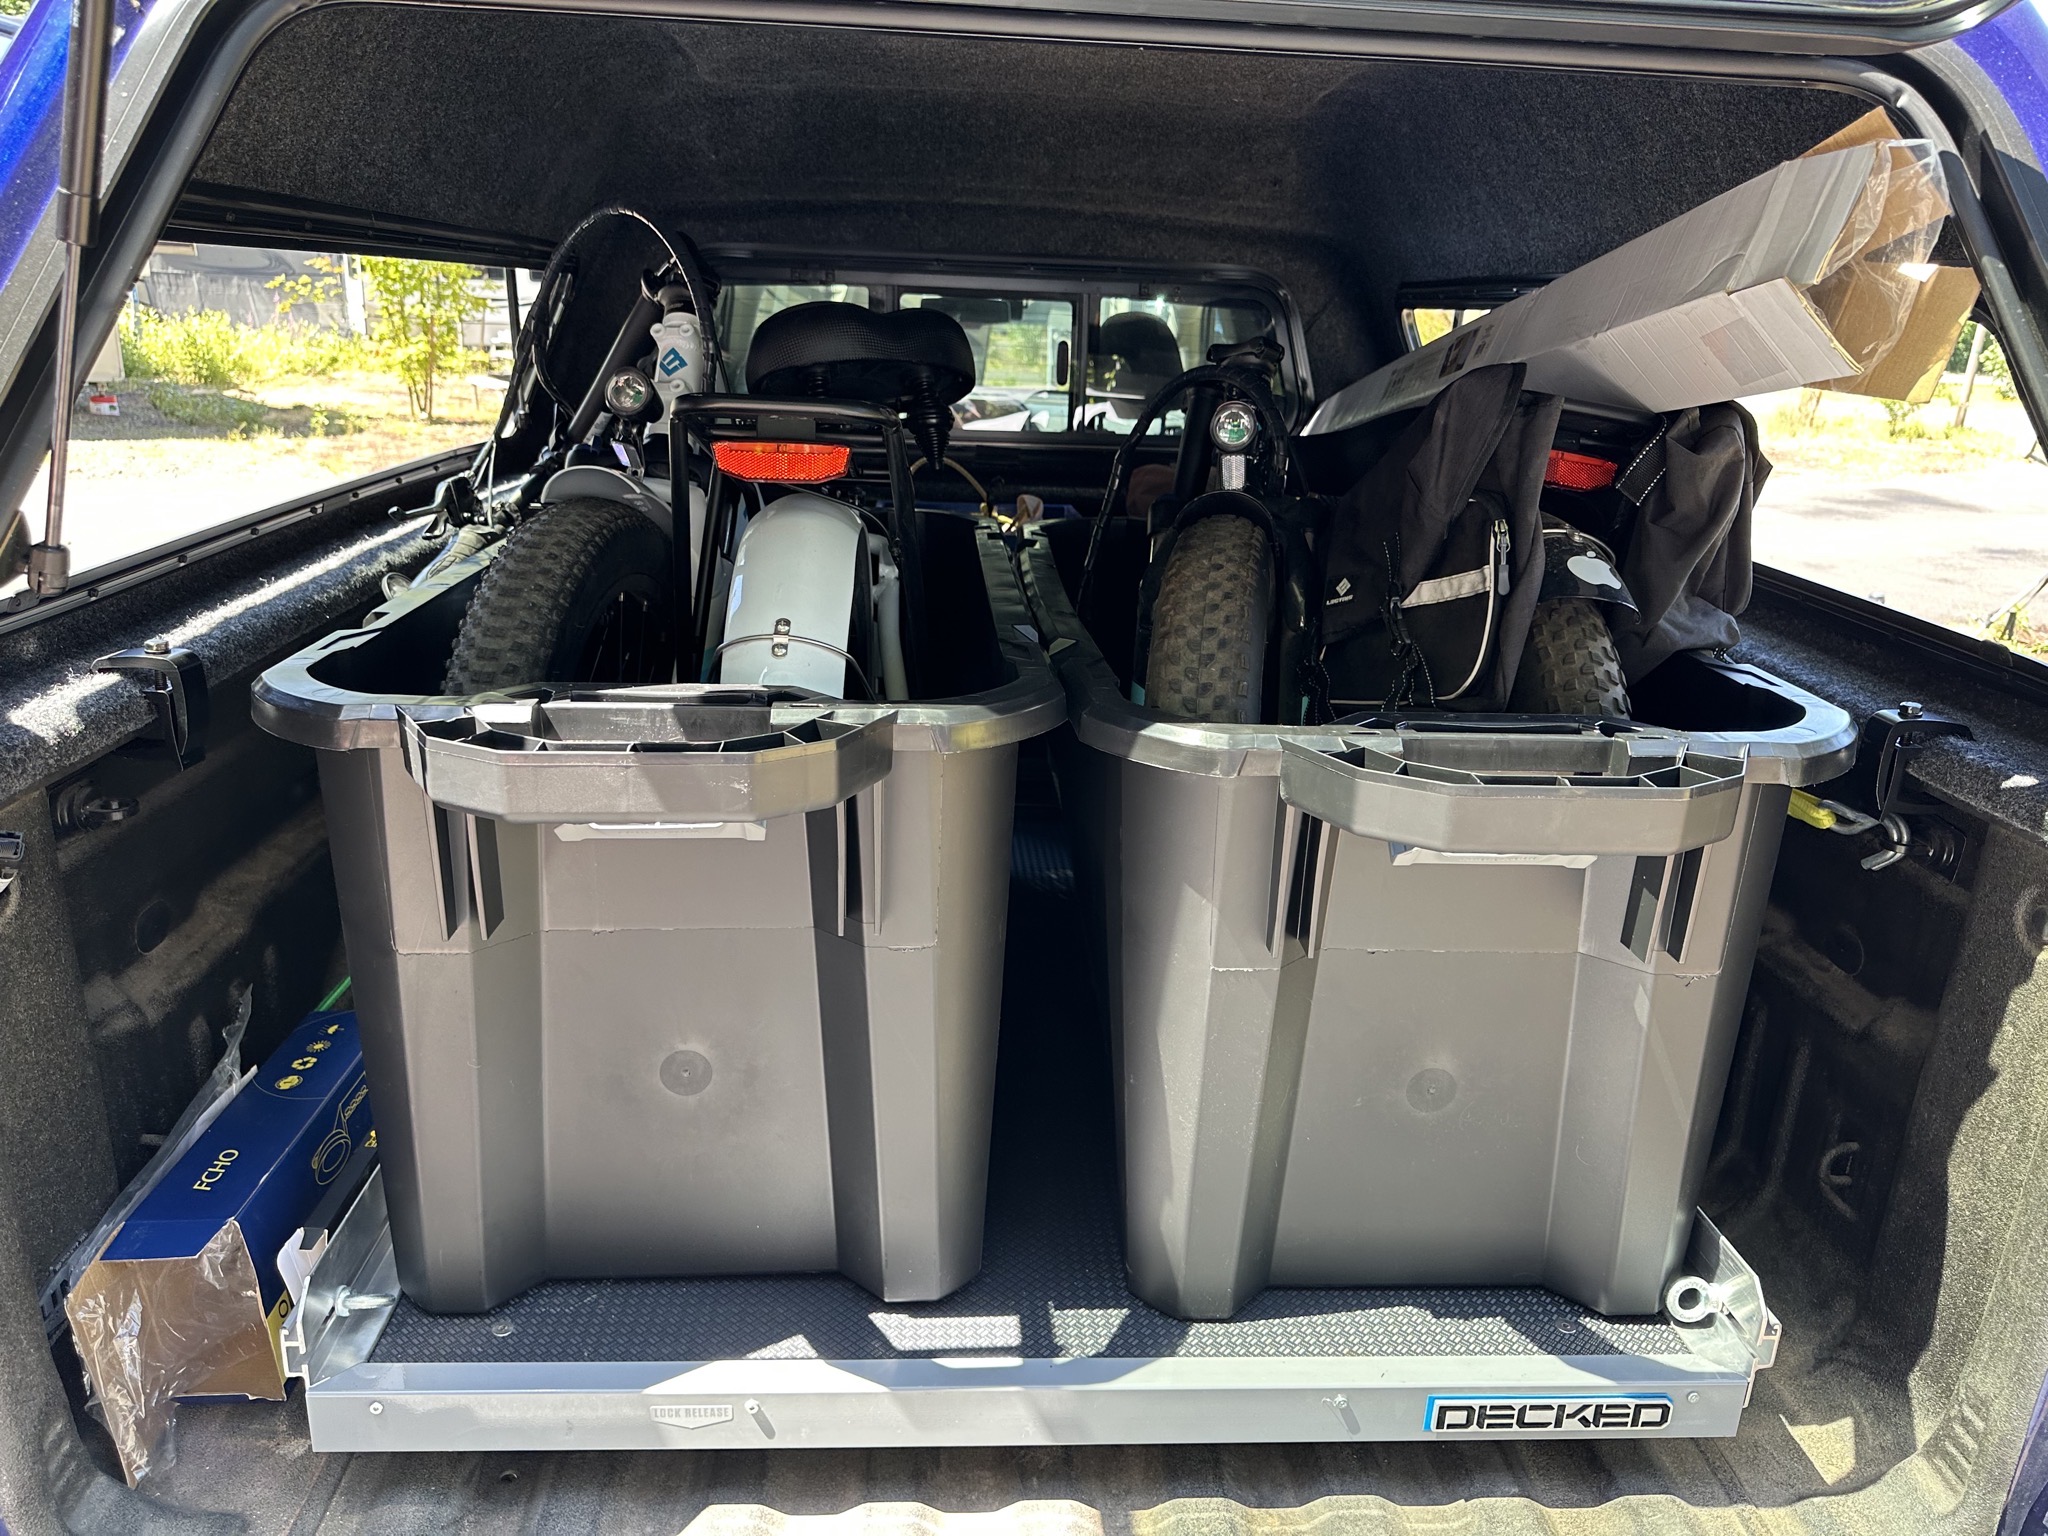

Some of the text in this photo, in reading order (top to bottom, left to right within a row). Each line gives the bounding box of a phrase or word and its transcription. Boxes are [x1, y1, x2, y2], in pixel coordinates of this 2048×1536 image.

[192, 1149, 239, 1191] FCHO
[654, 1407, 730, 1418] LOCK RELEASE
[1435, 1403, 1671, 1430] DECKED
